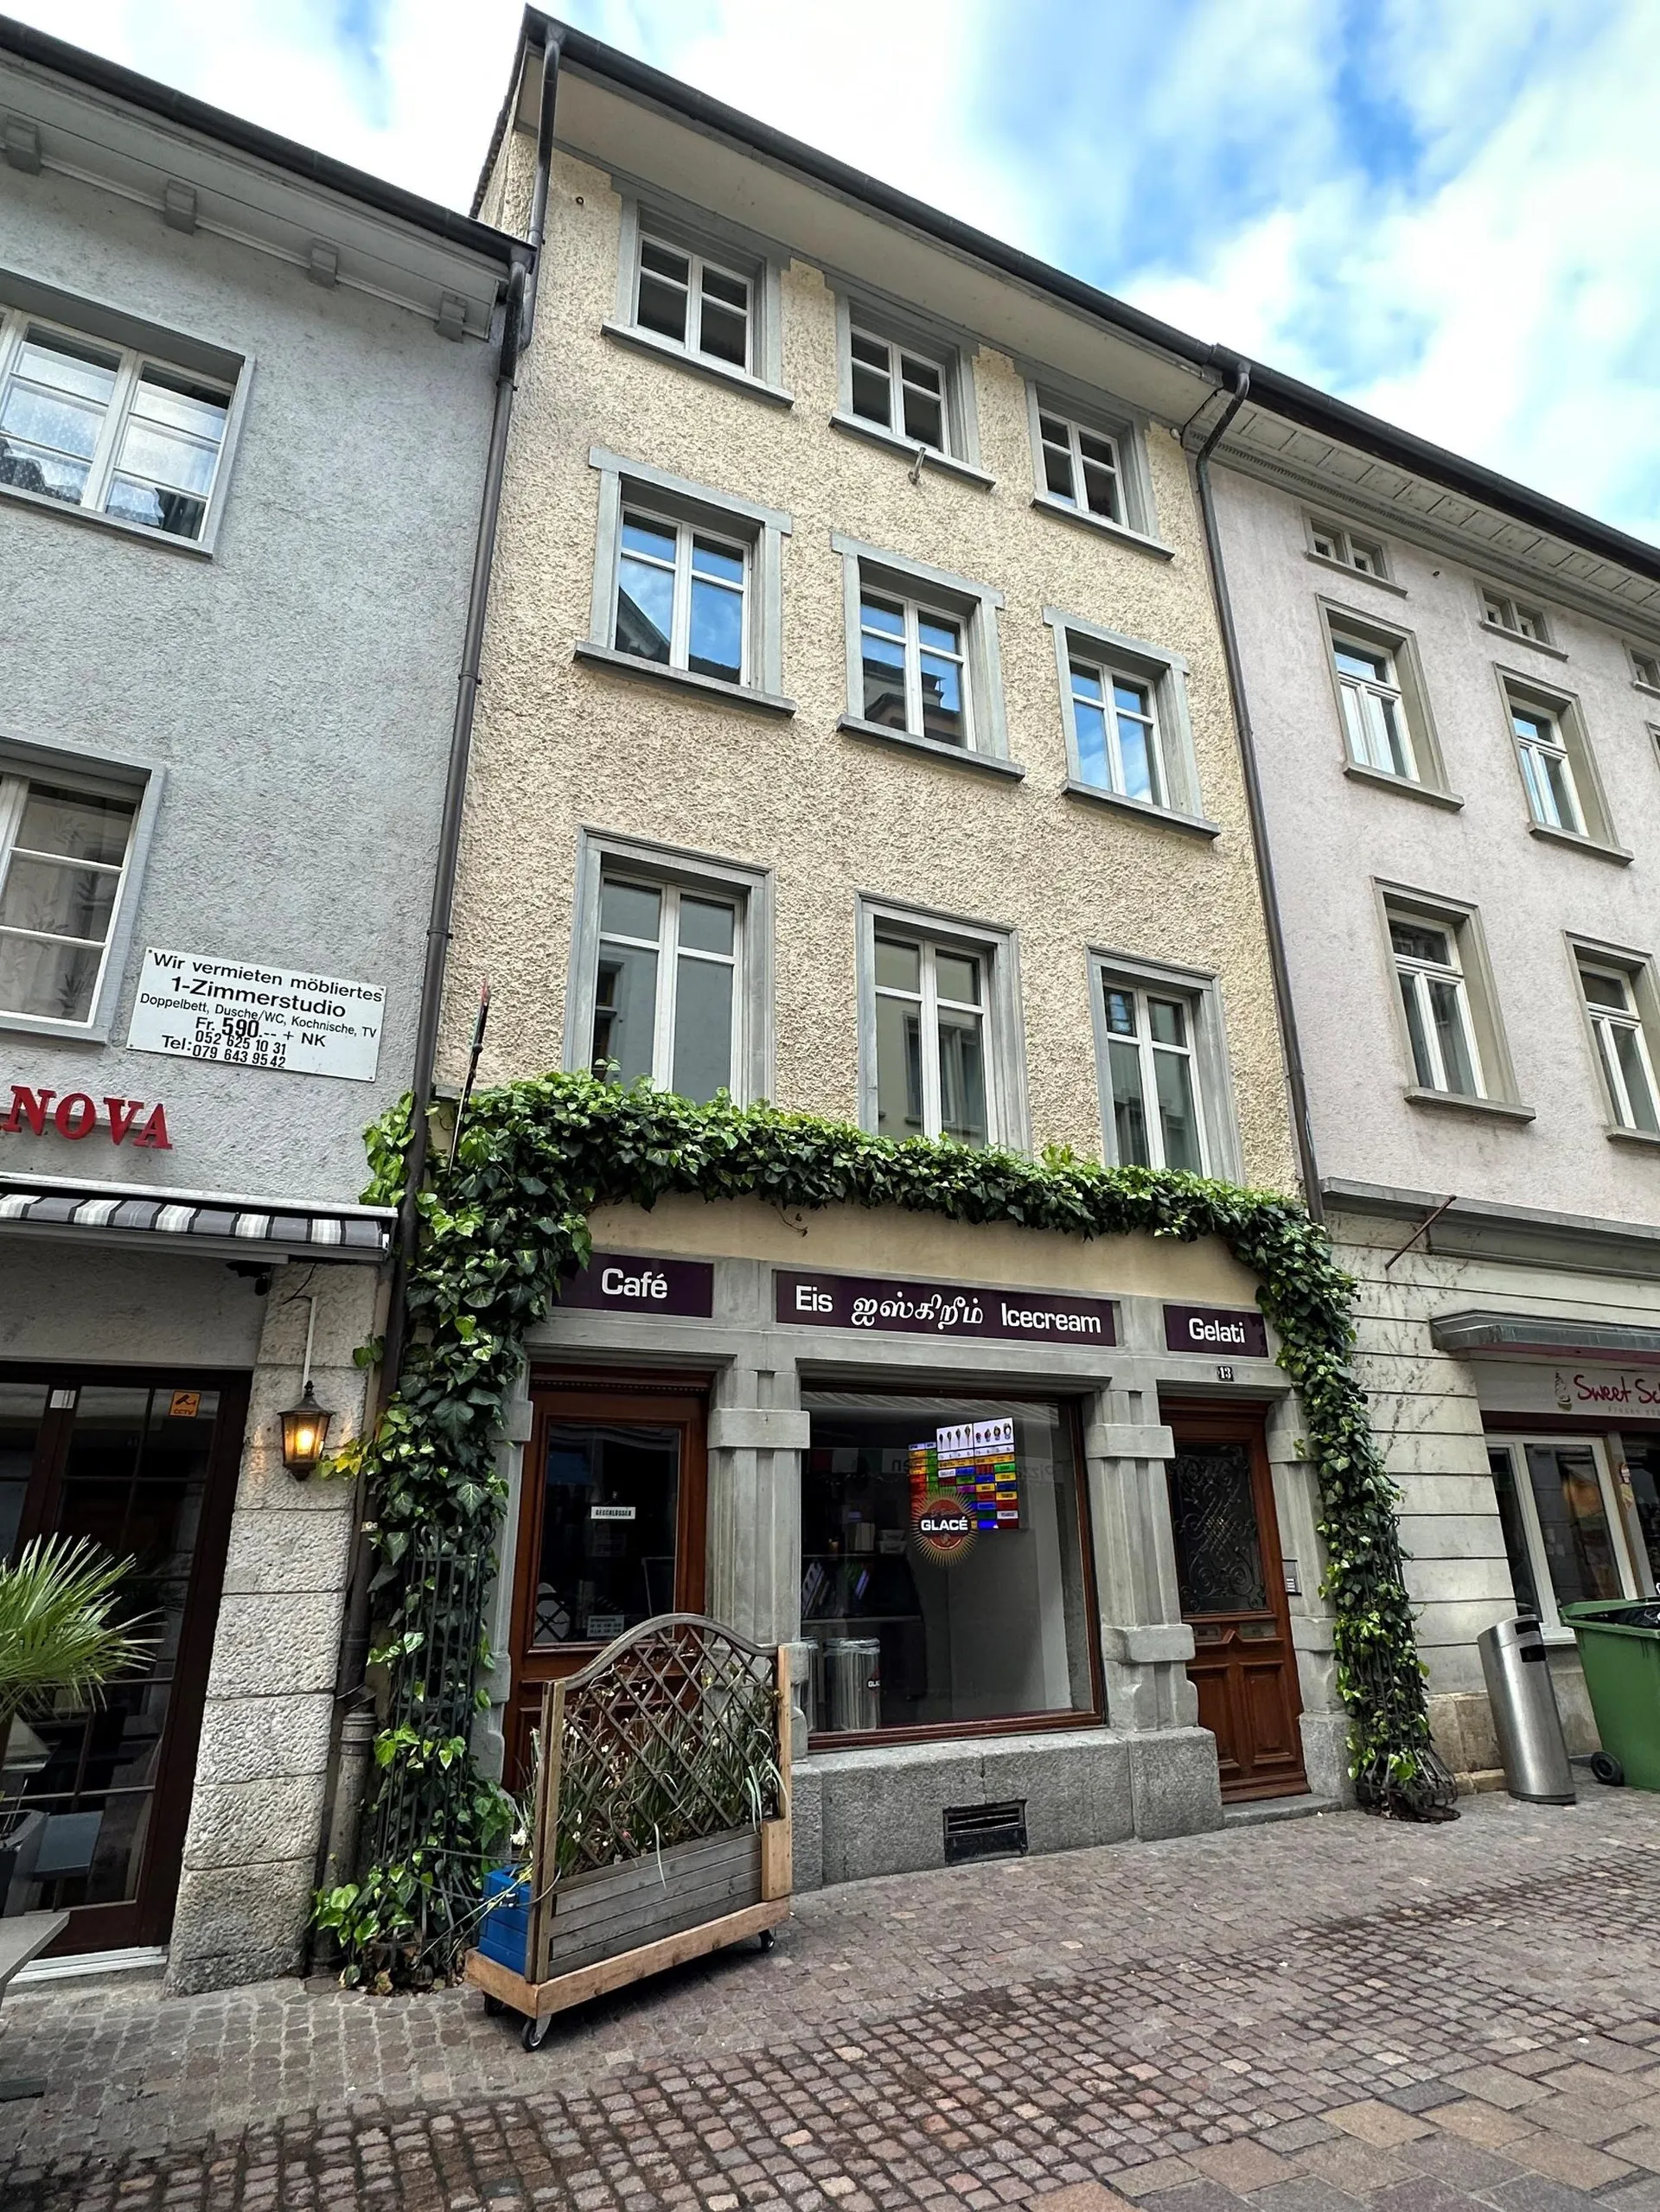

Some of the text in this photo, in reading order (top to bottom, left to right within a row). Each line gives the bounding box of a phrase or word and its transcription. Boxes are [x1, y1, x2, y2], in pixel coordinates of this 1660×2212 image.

[154, 953, 383, 1002] Wir vermieten möbliertes
[172, 976, 346, 1017] 1-Zimmerstudio
[140, 993, 378, 1038] Doppelbett, Dusche/WC, Kochnische, TV
[195, 1017, 215, 1031] Fr.
[283, 1030, 295, 1041] +
[301, 1032, 327, 1048] NK
[195, 1030, 287, 1055] 052 625 10 31
[224, 1048, 248, 1063] 643
[0, 1085, 173, 1151] NOVA
[601, 1268, 668, 1299] Café
[795, 1285, 833, 1313] Eis
[1001, 1303, 1101, 1335] Icecream
[1189, 1318, 1246, 1344] Gelati
[1218, 1366, 1232, 1380] 13
[1574, 1374, 1660, 1405] Sweet Sc
[920, 1516, 969, 1531] GLACÉ
